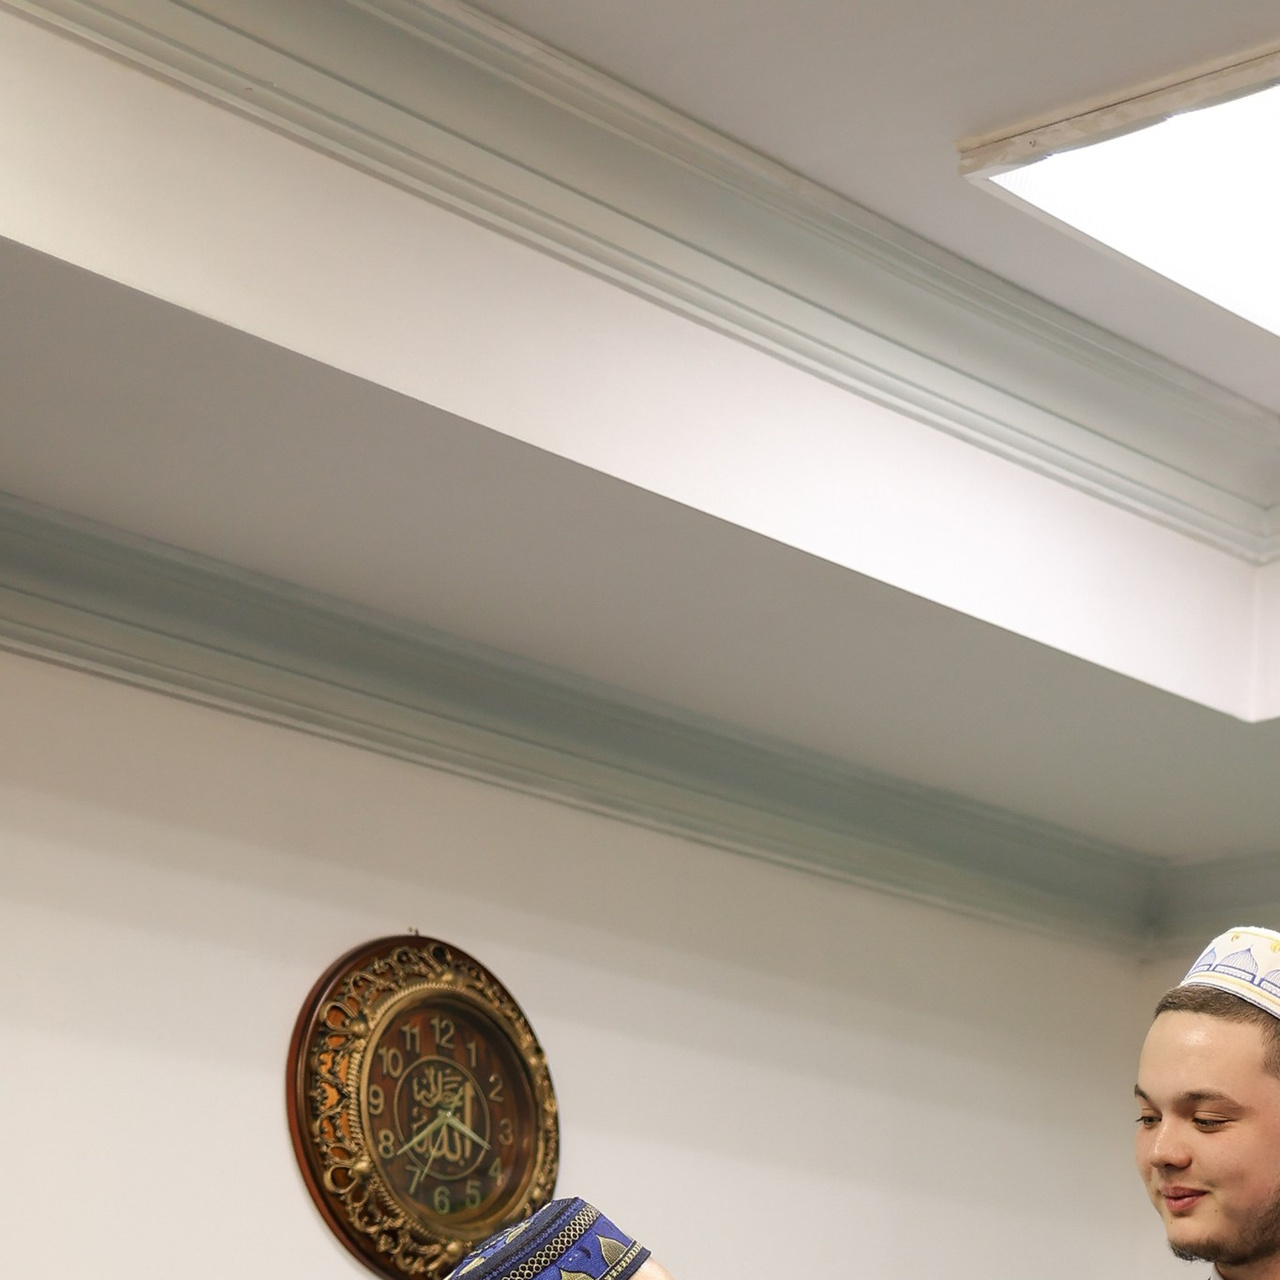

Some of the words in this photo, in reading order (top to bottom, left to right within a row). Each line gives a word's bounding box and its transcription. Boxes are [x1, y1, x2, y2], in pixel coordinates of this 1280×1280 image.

[401, 1023, 421, 1053] 11
[430, 1015, 456, 1049] 12
[377, 1047, 404, 1078] 10
[466, 1041, 477, 1068] 1
[368, 1084, 385, 1116] 9
[489, 1074, 505, 1102] 2
[378, 1128, 396, 1159] 8
[498, 1118, 514, 1146] 3
[404, 1164, 422, 1195] 7
[488, 1156, 504, 1187] 4
[433, 1185, 451, 1216] 6
[465, 1178, 482, 1210] 5
